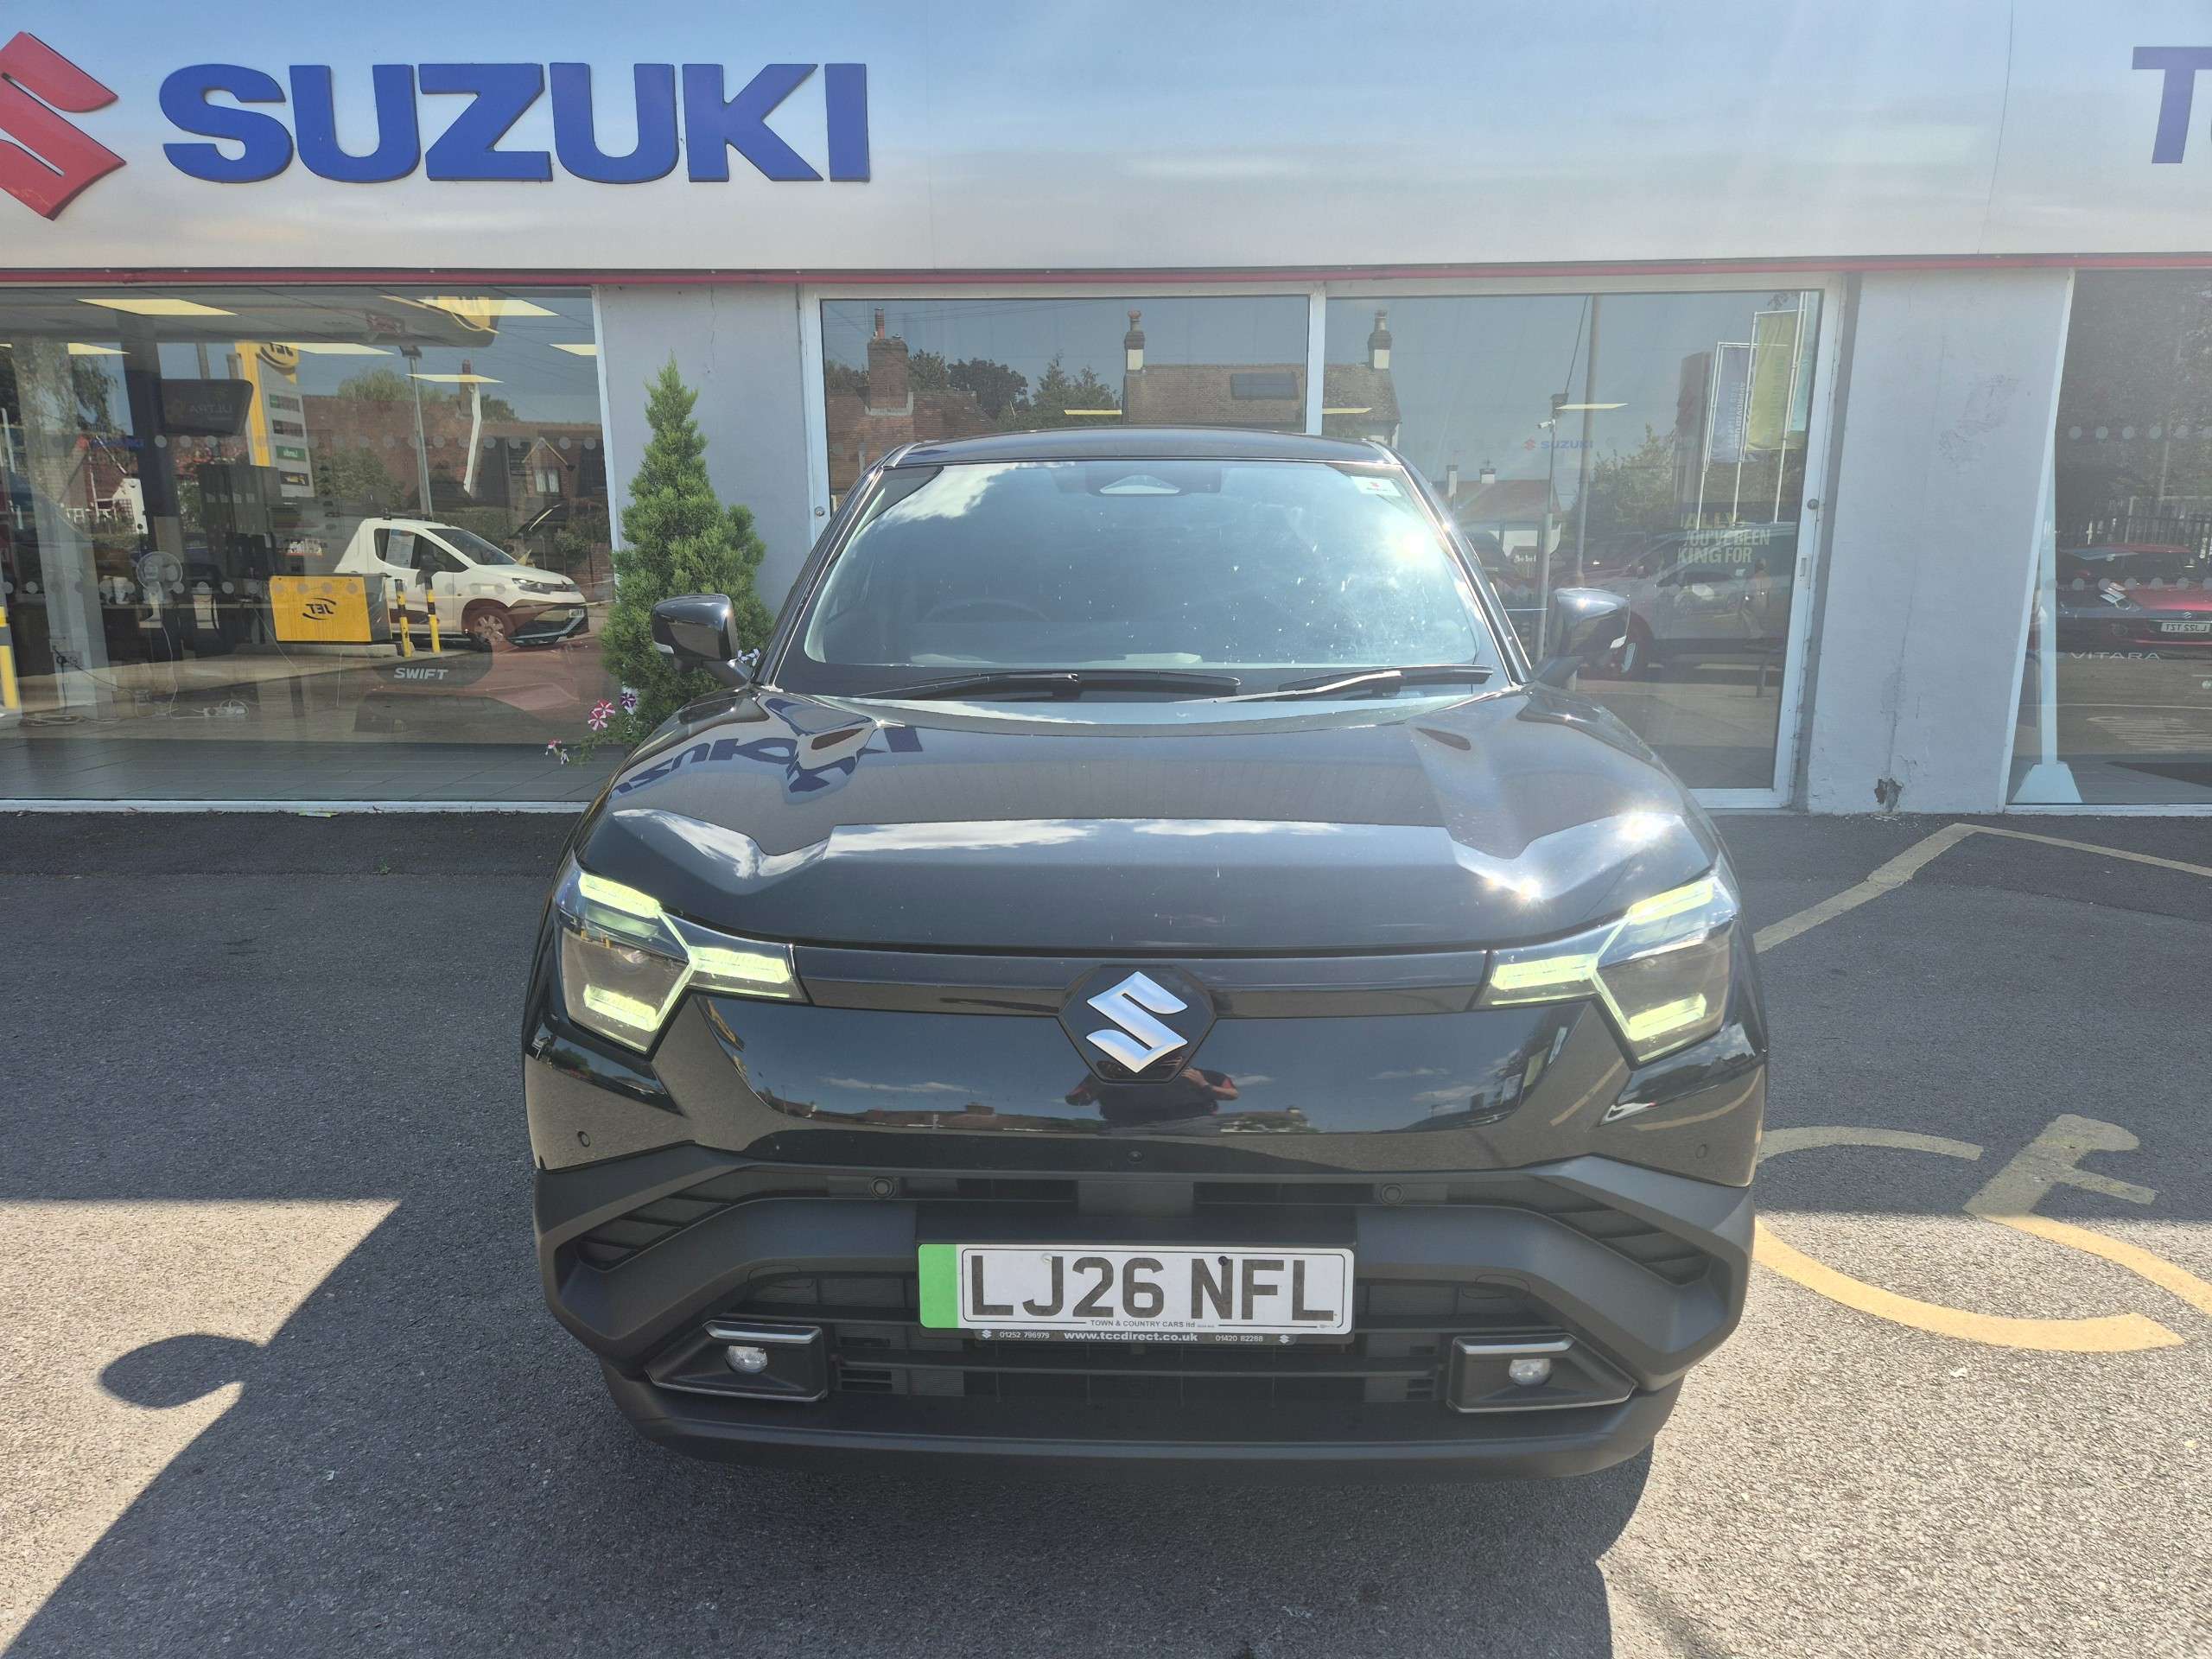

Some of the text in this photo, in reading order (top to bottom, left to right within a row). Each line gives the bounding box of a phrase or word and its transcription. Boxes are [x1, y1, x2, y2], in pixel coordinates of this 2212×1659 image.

[2132, 46, 2212, 164] T
[159, 62, 871, 185] SUZUKI
[1725, 547, 1752, 564] FOR
[2070, 652, 2160, 660] VITARA
[394, 667, 449, 680] SWIFT
[971, 1255, 1335, 1321] LJ26 NFL
[1064, 1331, 1198, 1342] www.tccdirect.co.uk
